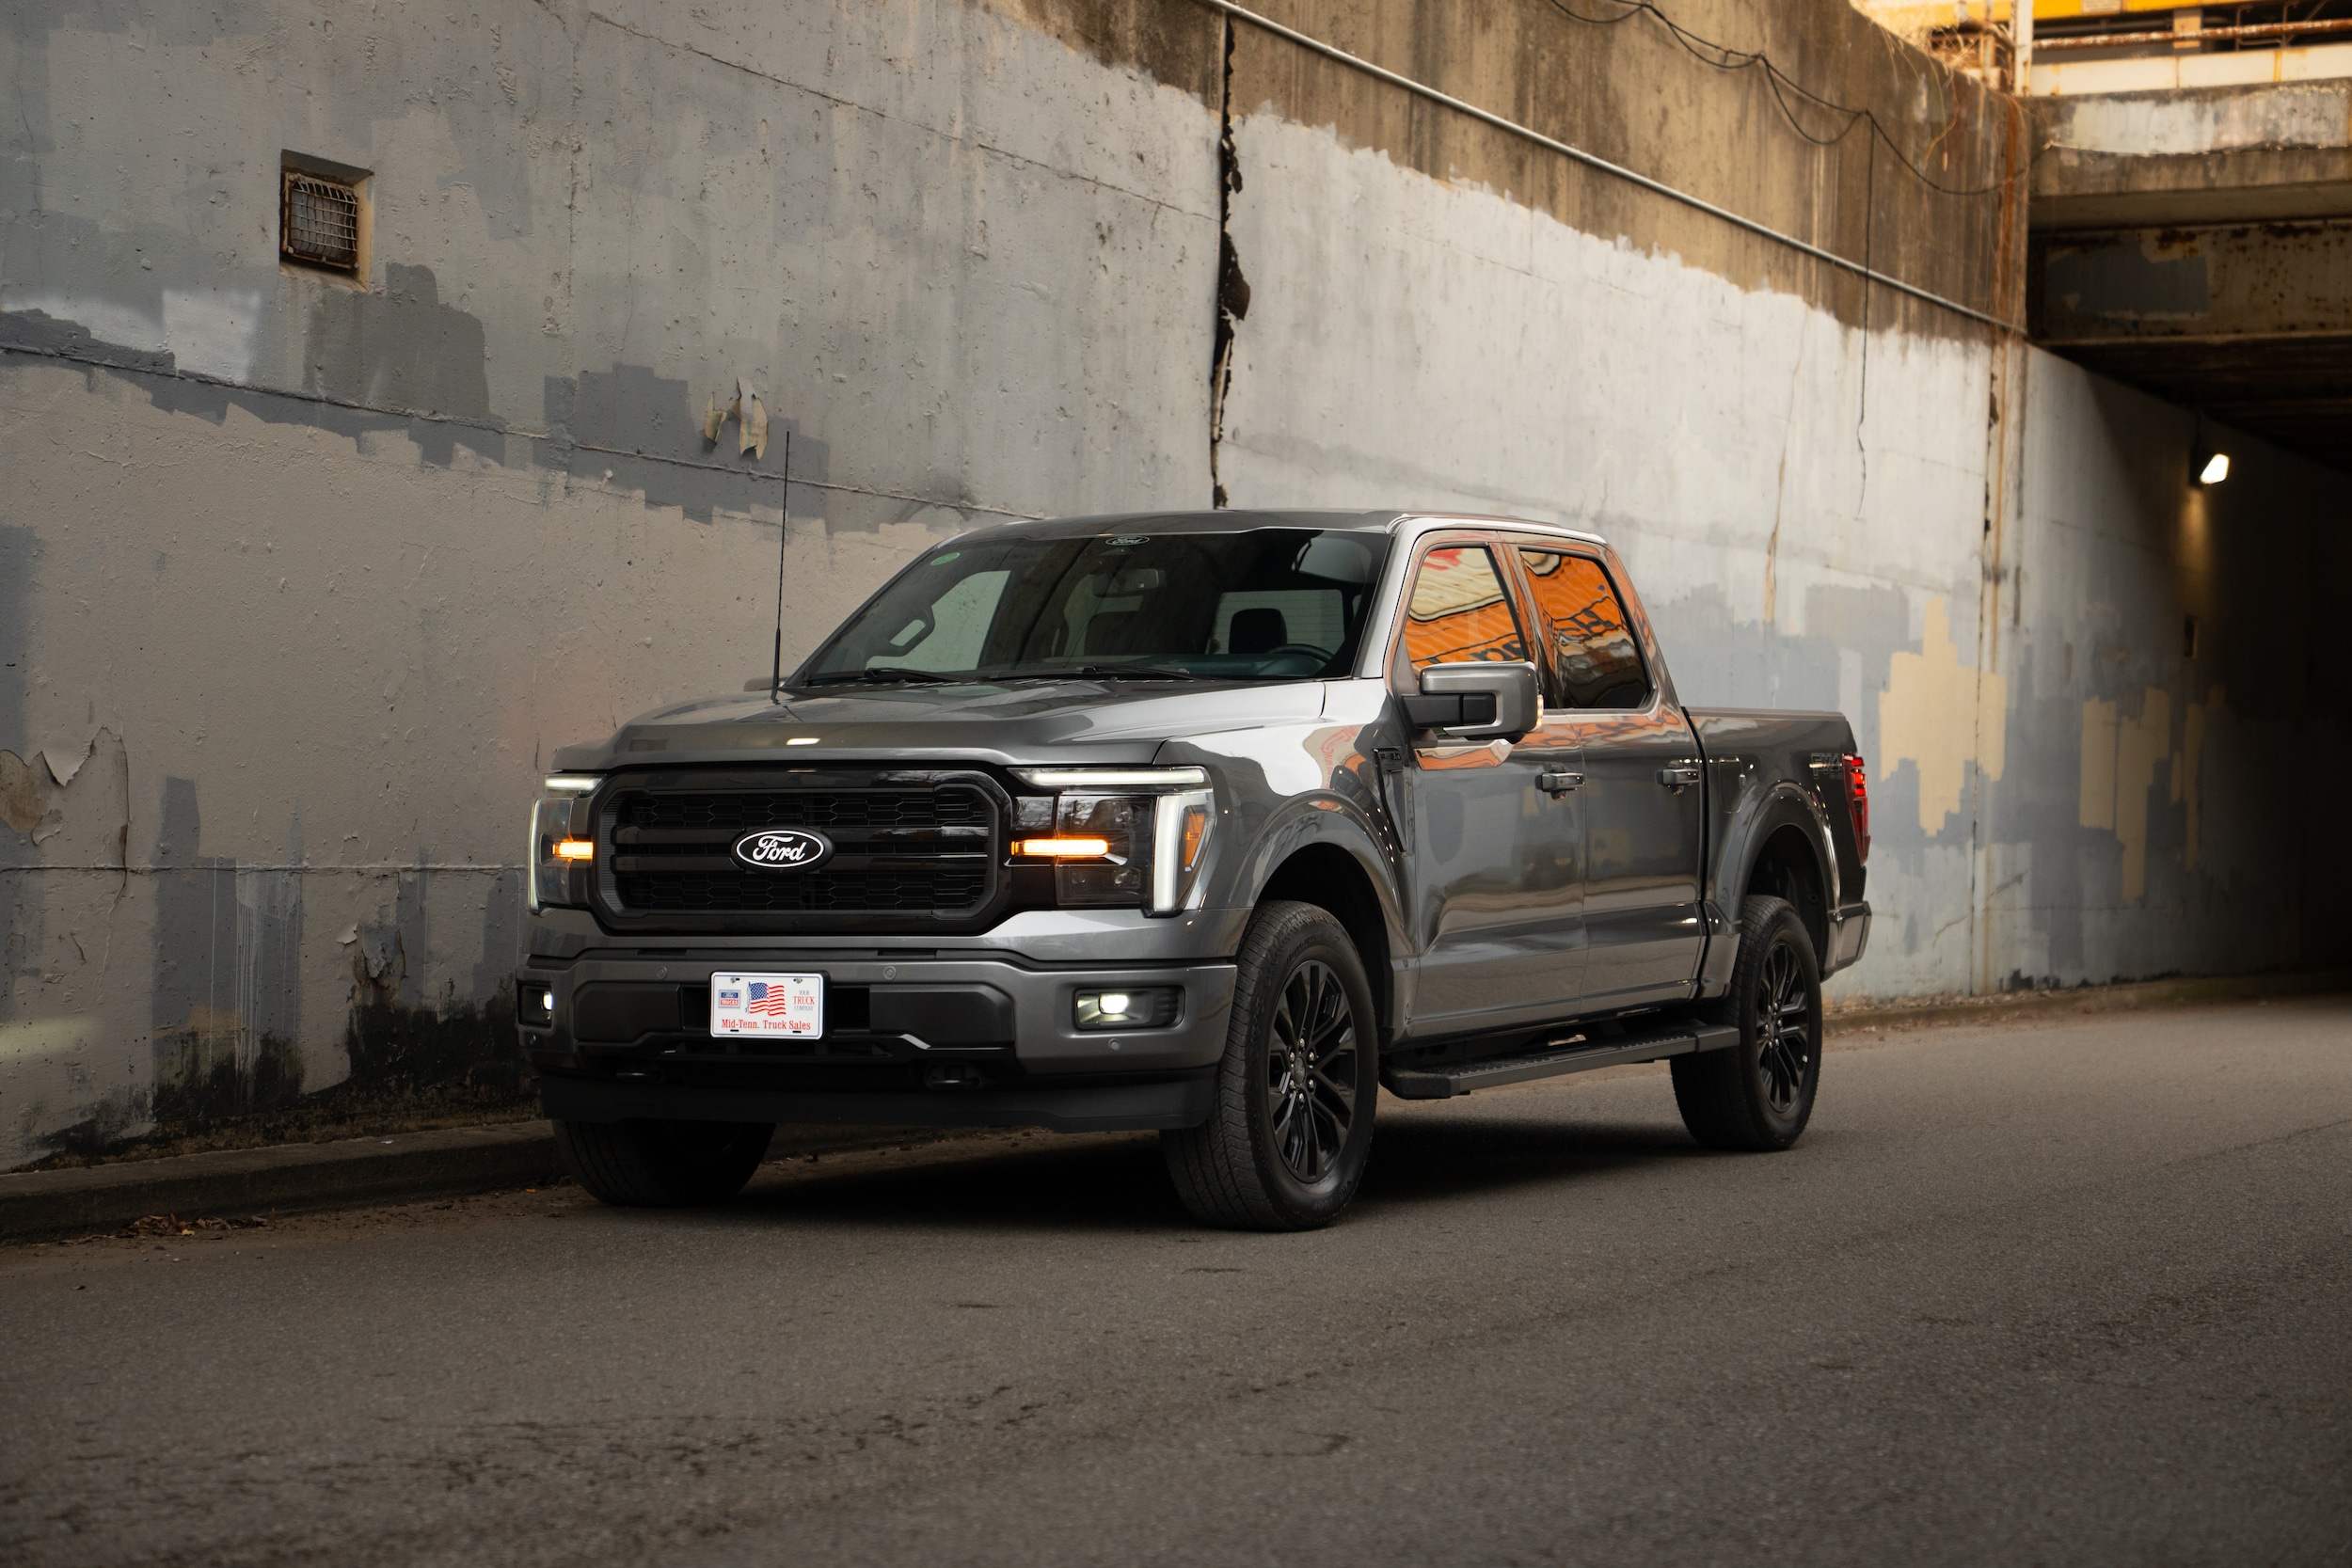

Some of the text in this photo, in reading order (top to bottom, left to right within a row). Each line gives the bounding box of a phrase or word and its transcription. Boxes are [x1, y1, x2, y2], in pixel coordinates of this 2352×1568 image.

[753, 835, 807, 861] Ford
[793, 996, 815, 1005] TRUCK
[722, 1019, 811, 1030] Mid-Tenn. Truck Sales
